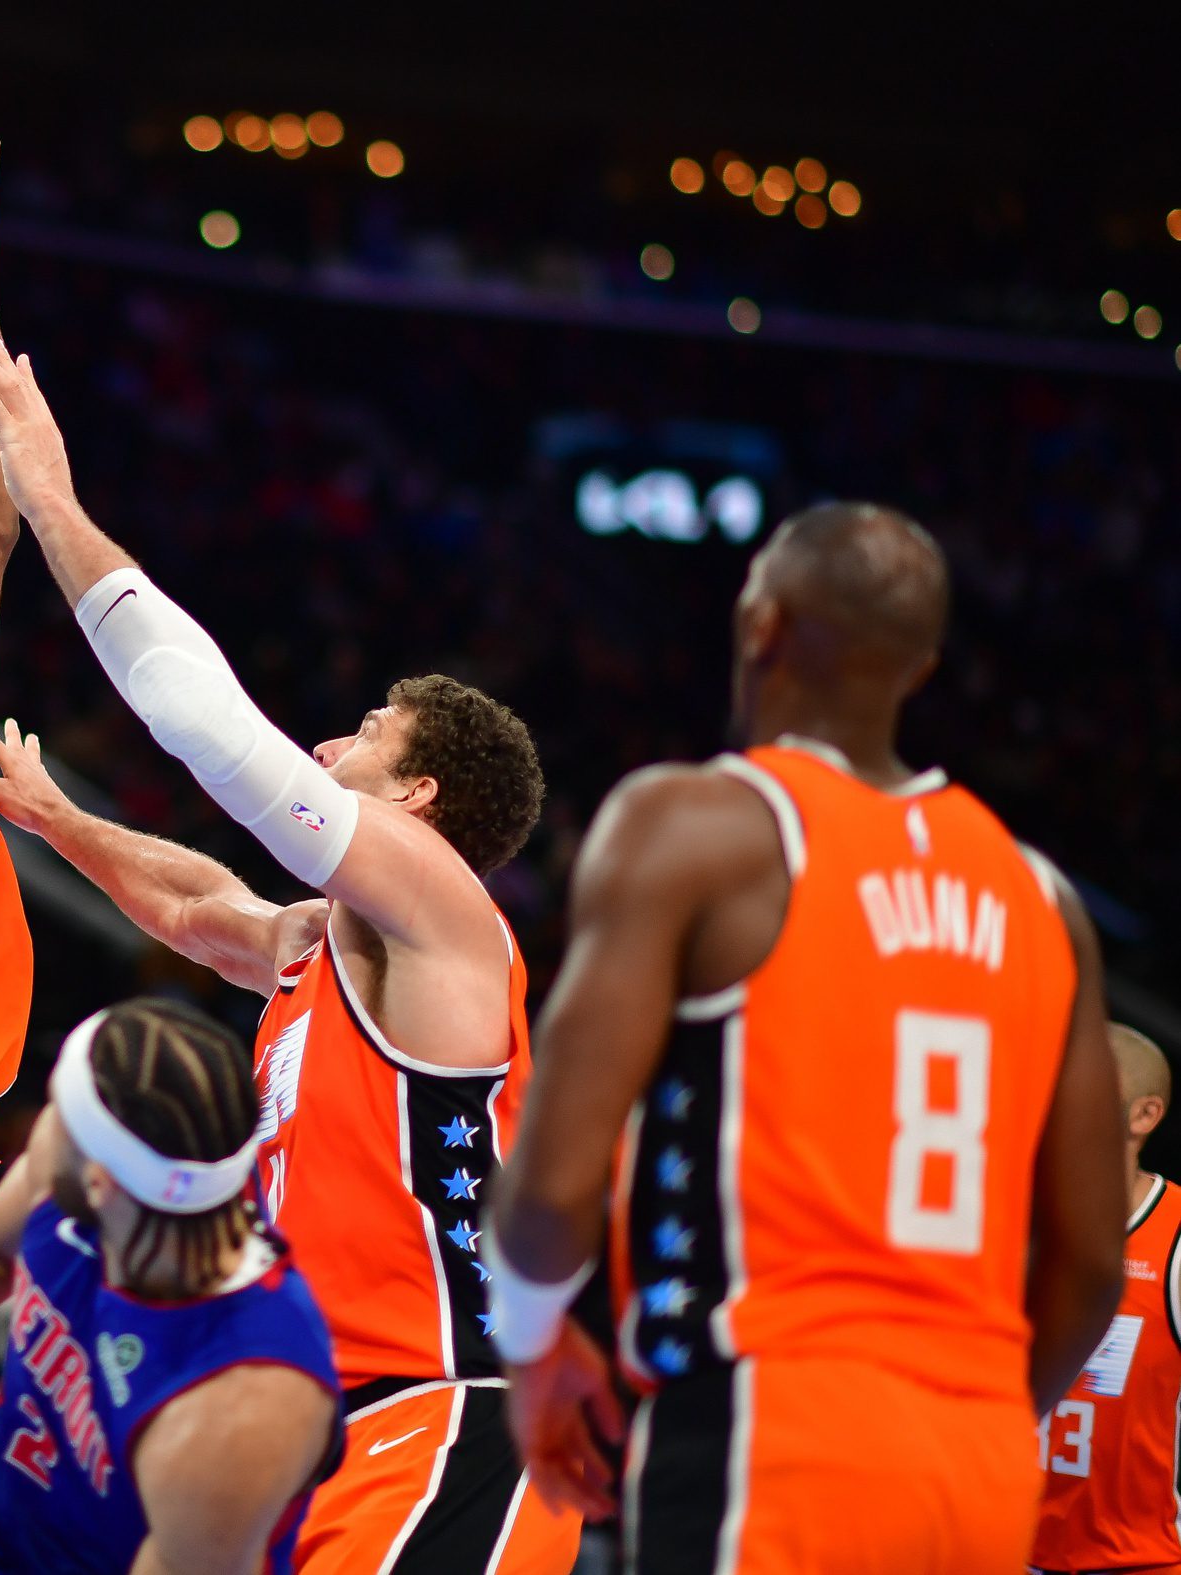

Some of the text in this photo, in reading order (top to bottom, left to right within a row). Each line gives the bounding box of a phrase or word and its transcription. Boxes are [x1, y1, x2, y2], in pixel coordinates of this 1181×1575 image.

[858, 866, 1007, 974] DUNN
[886, 1007, 991, 1256] 8
[3, 1393, 60, 1493] 2
